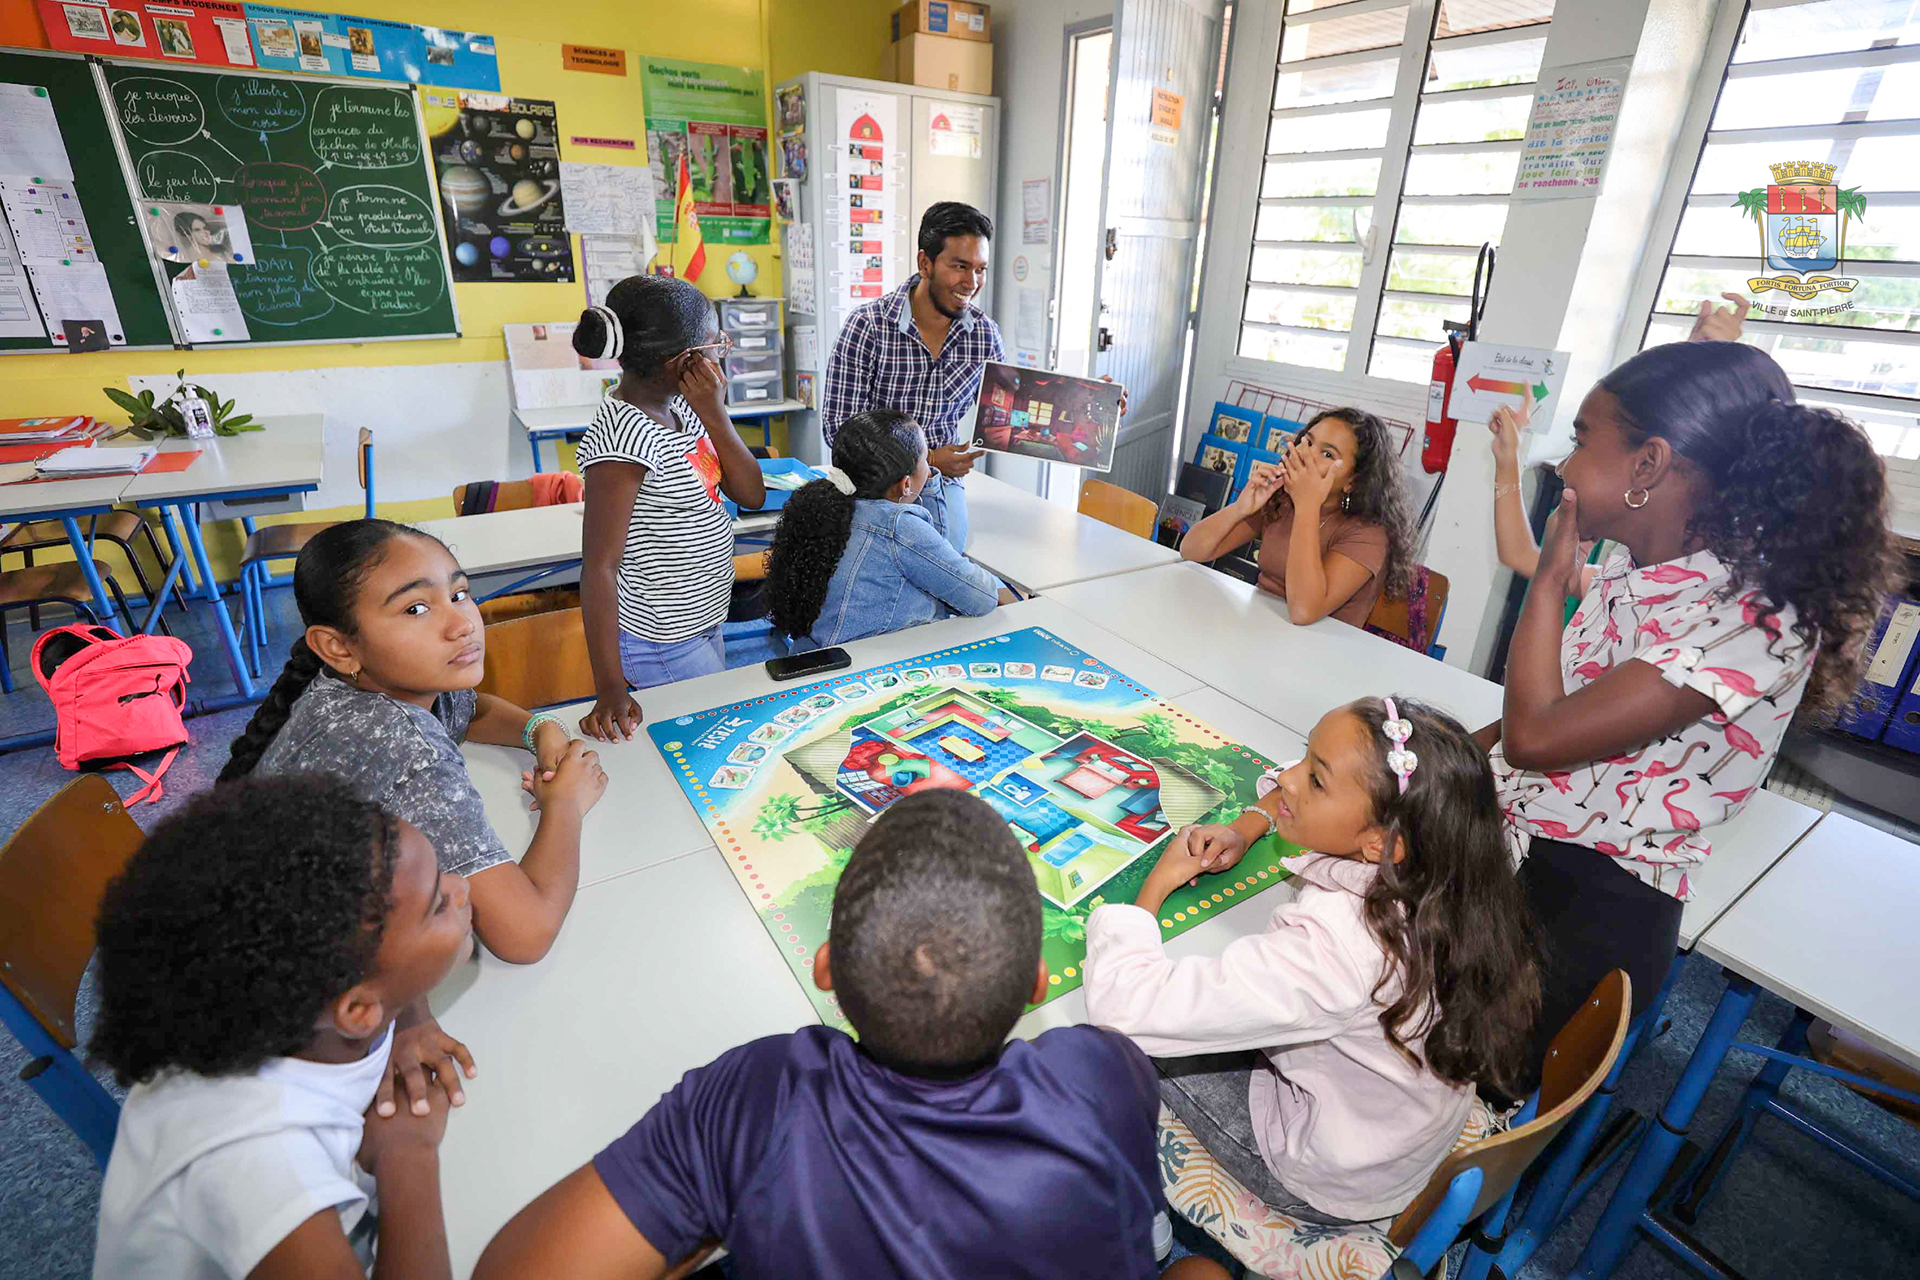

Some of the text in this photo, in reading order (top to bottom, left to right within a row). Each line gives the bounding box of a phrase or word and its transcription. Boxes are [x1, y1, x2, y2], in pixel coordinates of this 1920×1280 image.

[182, 0, 238, 12] MODERNES
[573, 46, 608, 58] SCIENCES
[571, 56, 621, 68] TECHNOLOGIE
[124, 90, 194, 113] je recopie
[329, 95, 410, 123] je termine les
[442, 97, 456, 109] LE
[510, 101, 555, 117] SOLAIRE
[149, 106, 197, 124] devoirs
[312, 123, 386, 137] exercices du
[315, 135, 360, 160] fichier
[364, 138, 378, 150] de
[590, 137, 635, 147] RECHERCHES
[1527, 139, 1546, 149] dit
[1551, 138, 1563, 147] la
[1523, 158, 1604, 170] travaille dur
[146, 164, 211, 196] le jeu du
[1519, 170, 1544, 181] joue
[1532, 179, 1578, 189] ronchonne
[1582, 177, 1600, 187] pas
[339, 189, 408, 214] je termine
[330, 209, 425, 228] mes productions
[337, 227, 356, 236] en
[391, 220, 434, 235] Visuels
[323, 253, 335, 269] je
[385, 249, 401, 263] les
[403, 248, 431, 261] mots
[315, 263, 331, 277] de
[337, 261, 351, 275] la
